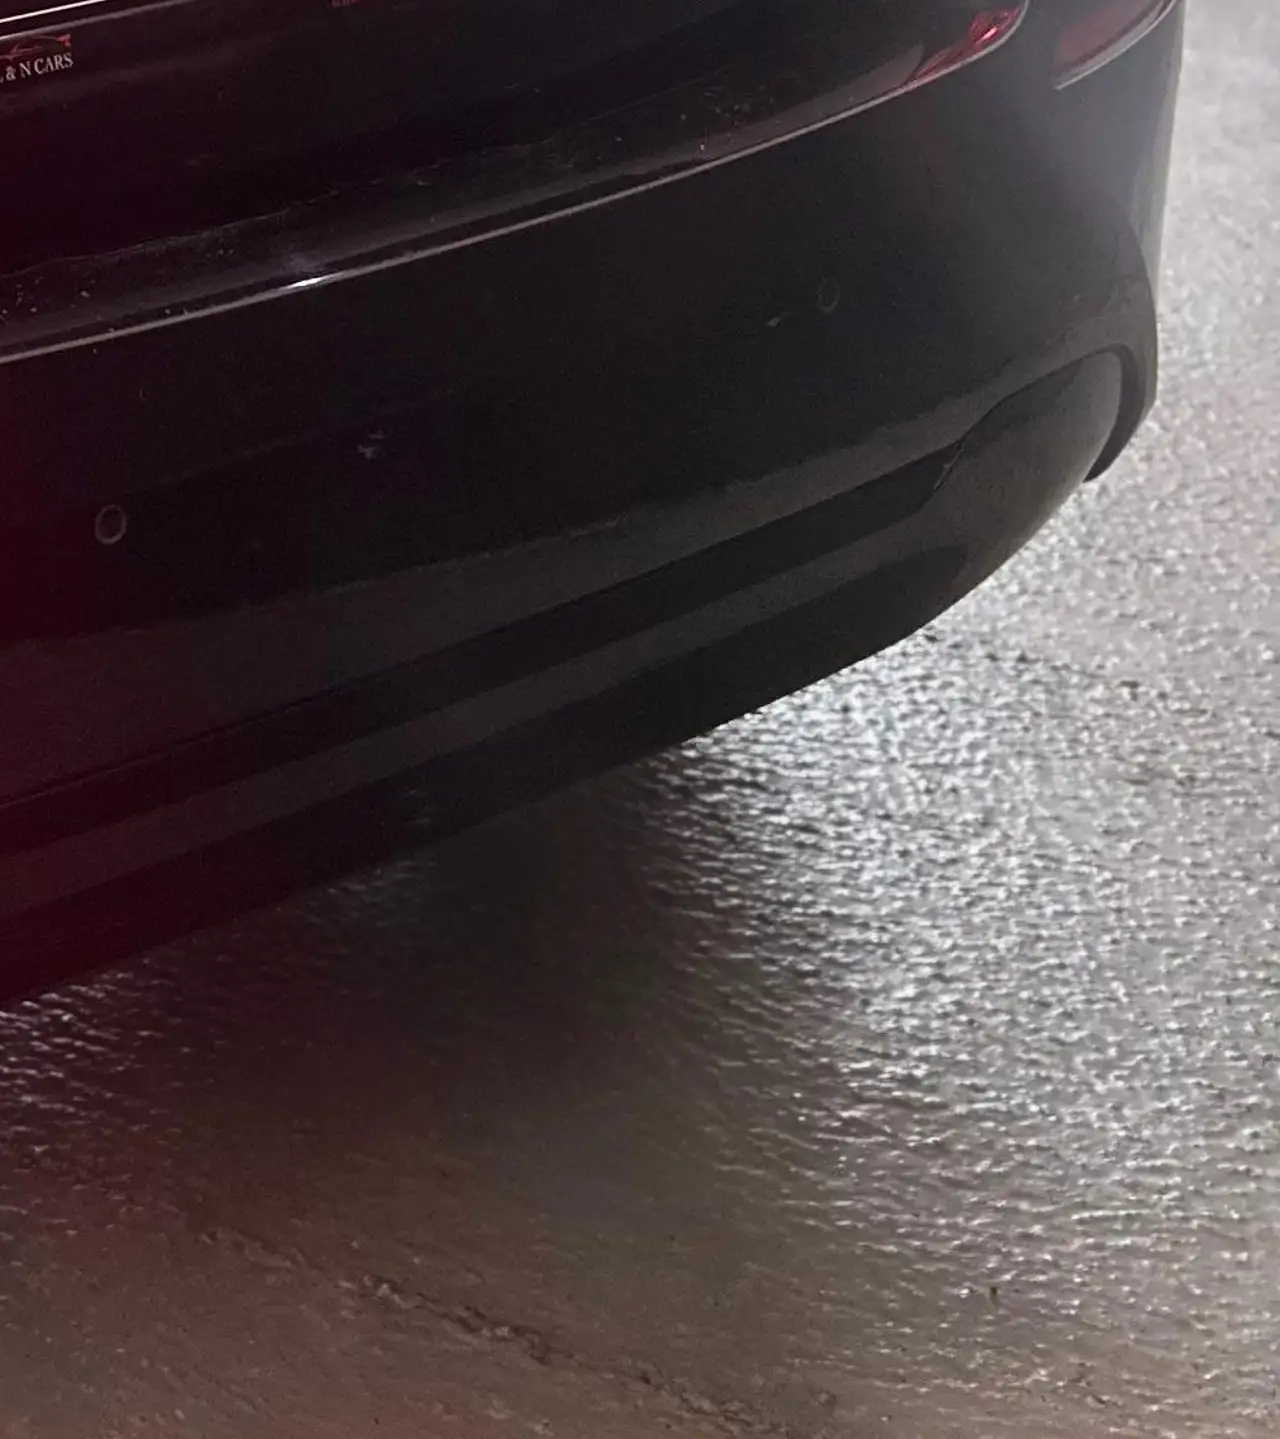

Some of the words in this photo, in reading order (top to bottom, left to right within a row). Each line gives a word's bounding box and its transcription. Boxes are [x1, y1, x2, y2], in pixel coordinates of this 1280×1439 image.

[6, 66, 17, 81] &
[19, 60, 32, 79] N
[34, 52, 74, 75] CARS
